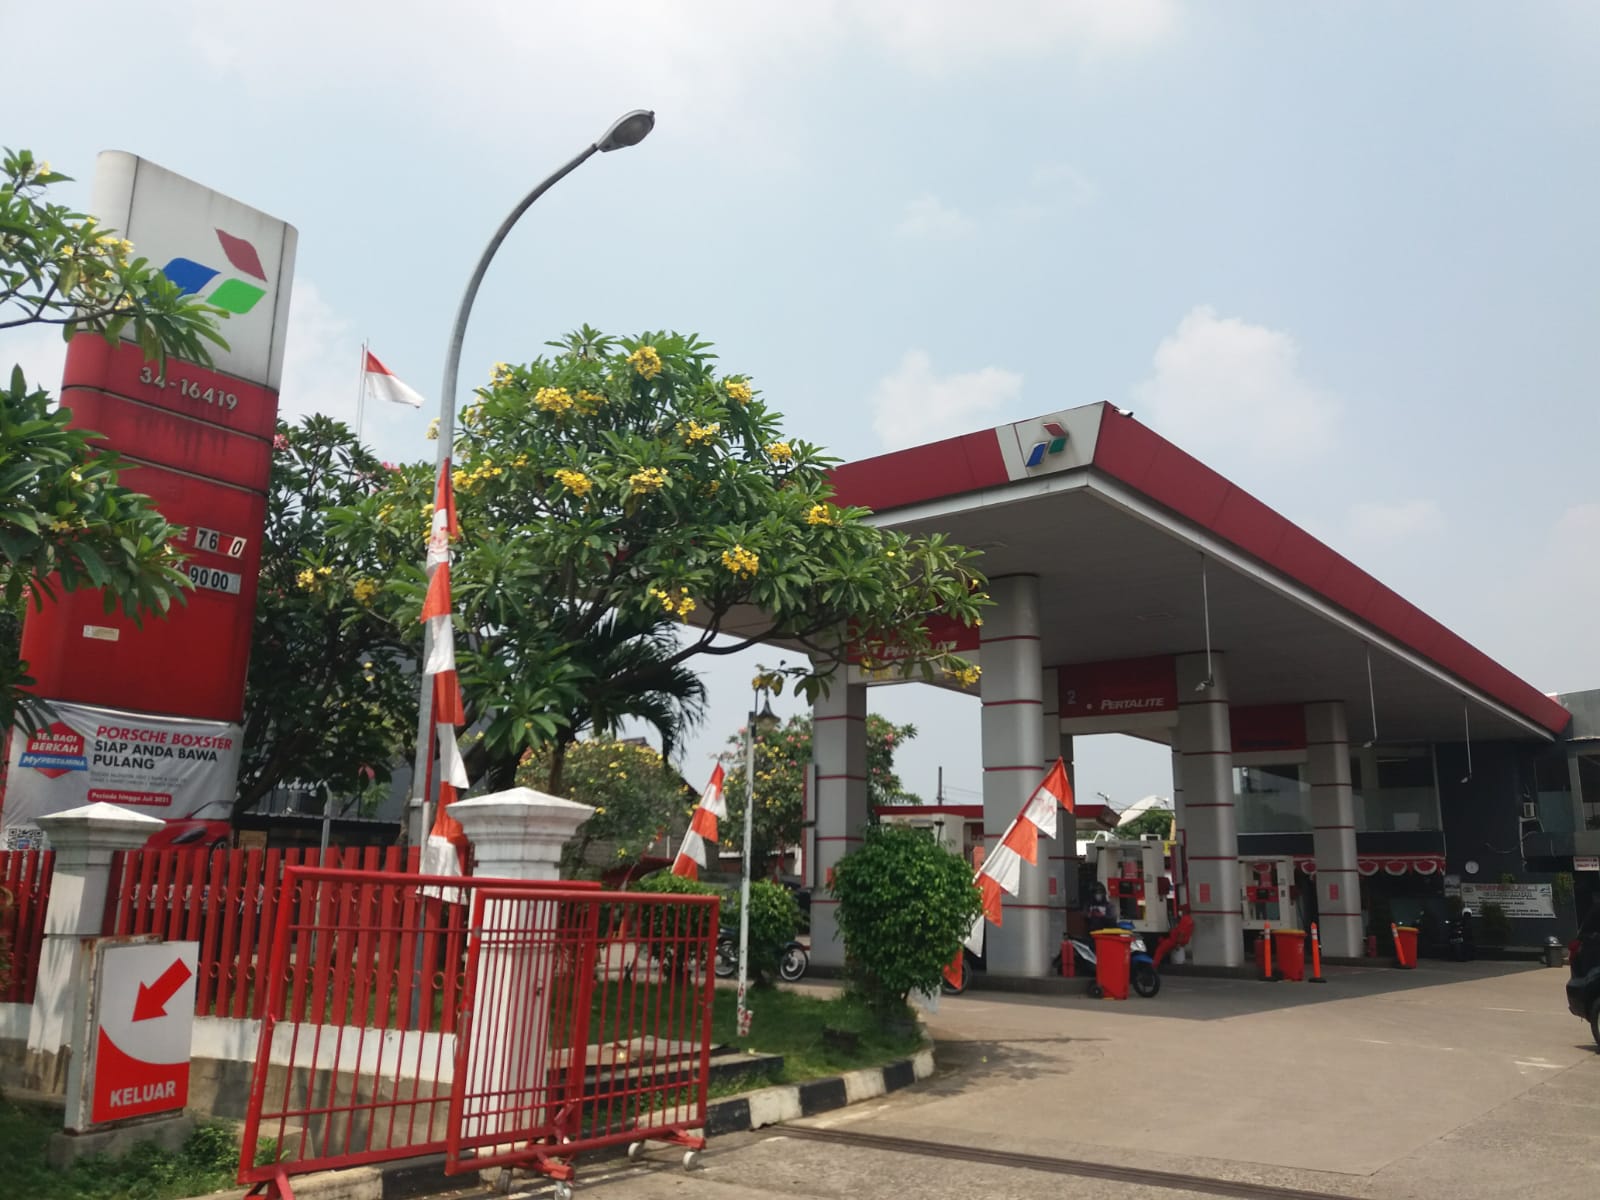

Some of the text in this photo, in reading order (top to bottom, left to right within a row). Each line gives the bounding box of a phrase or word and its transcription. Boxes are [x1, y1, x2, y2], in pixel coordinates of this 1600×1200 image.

[139, 366, 238, 411] 34-16419
[190, 567, 229, 590] 9000
[1101, 698, 1165, 711] PERTALITE
[31, 741, 79, 754] BERKAH
[96, 725, 233, 751] PORSCHE BOXSTER
[93, 754, 155, 770] PULANG
[94, 740, 218, 762] SIAP ANDA BAWA
[109, 1080, 176, 1108] KELUAR
